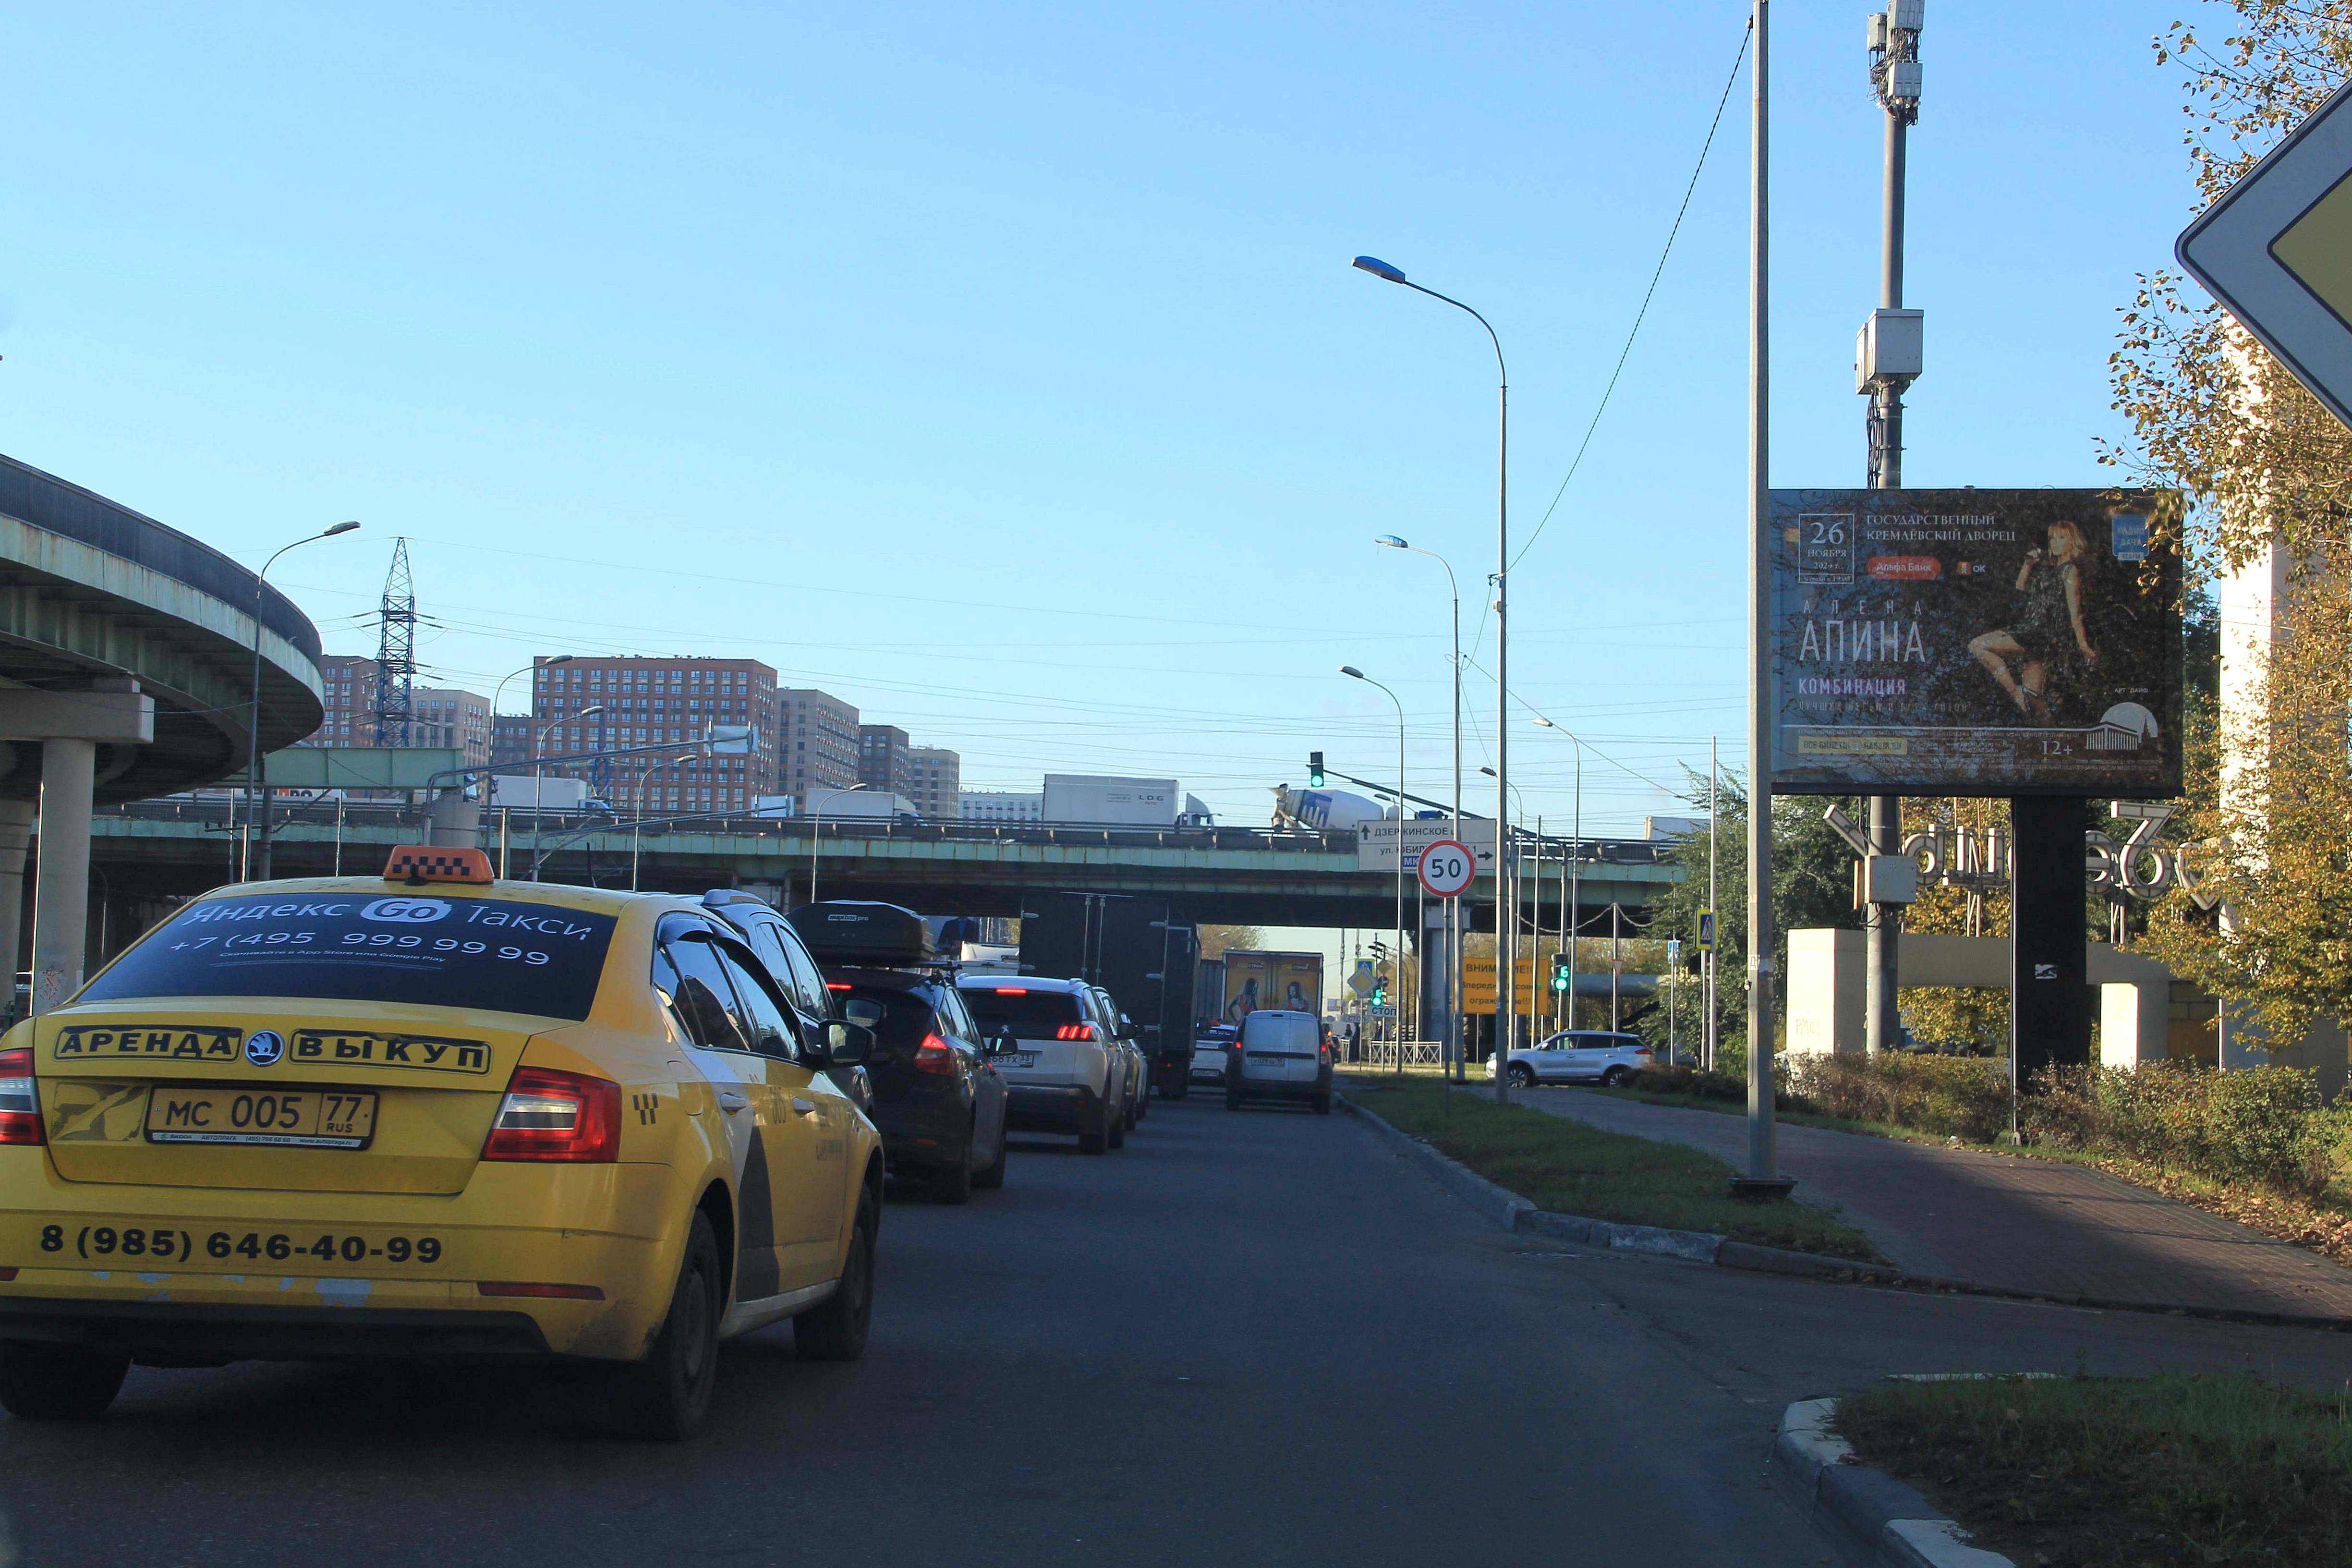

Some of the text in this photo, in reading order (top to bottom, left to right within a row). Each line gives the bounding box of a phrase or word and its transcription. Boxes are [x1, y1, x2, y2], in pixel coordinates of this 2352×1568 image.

[1867, 513, 1995, 525] ГОСУДАРСТВЕННЫЙ
[1810, 522, 1844, 545] 26
[1964, 530, 2016, 542] ДВОРЕЦ
[1807, 549, 1847, 558] НОЯБРЯ
[1799, 620, 1925, 662] АПИНА
[1799, 678, 1906, 697] КОМБИНАЦИЯ
[2041, 740, 2073, 755] 12+
[1381, 847, 1393, 856] ул.
[1431, 858, 1461, 878] 50
[181, 899, 593, 941] Яндекс Go Такси
[170, 936, 218, 951] +7
[341, 933, 423, 948] 999
[433, 939, 486, 954] 99
[497, 947, 549, 965] 99
[1372, 1007, 1397, 1016] СТОП
[60, 1033, 232, 1057] АРЕНДА
[298, 1036, 484, 1069] ВЫКУП
[165, 1094, 363, 1129] МС 005 77
[326, 1122, 352, 1133] RUS
[40, 1225, 443, 1264] 8 (985) 646-40-99
